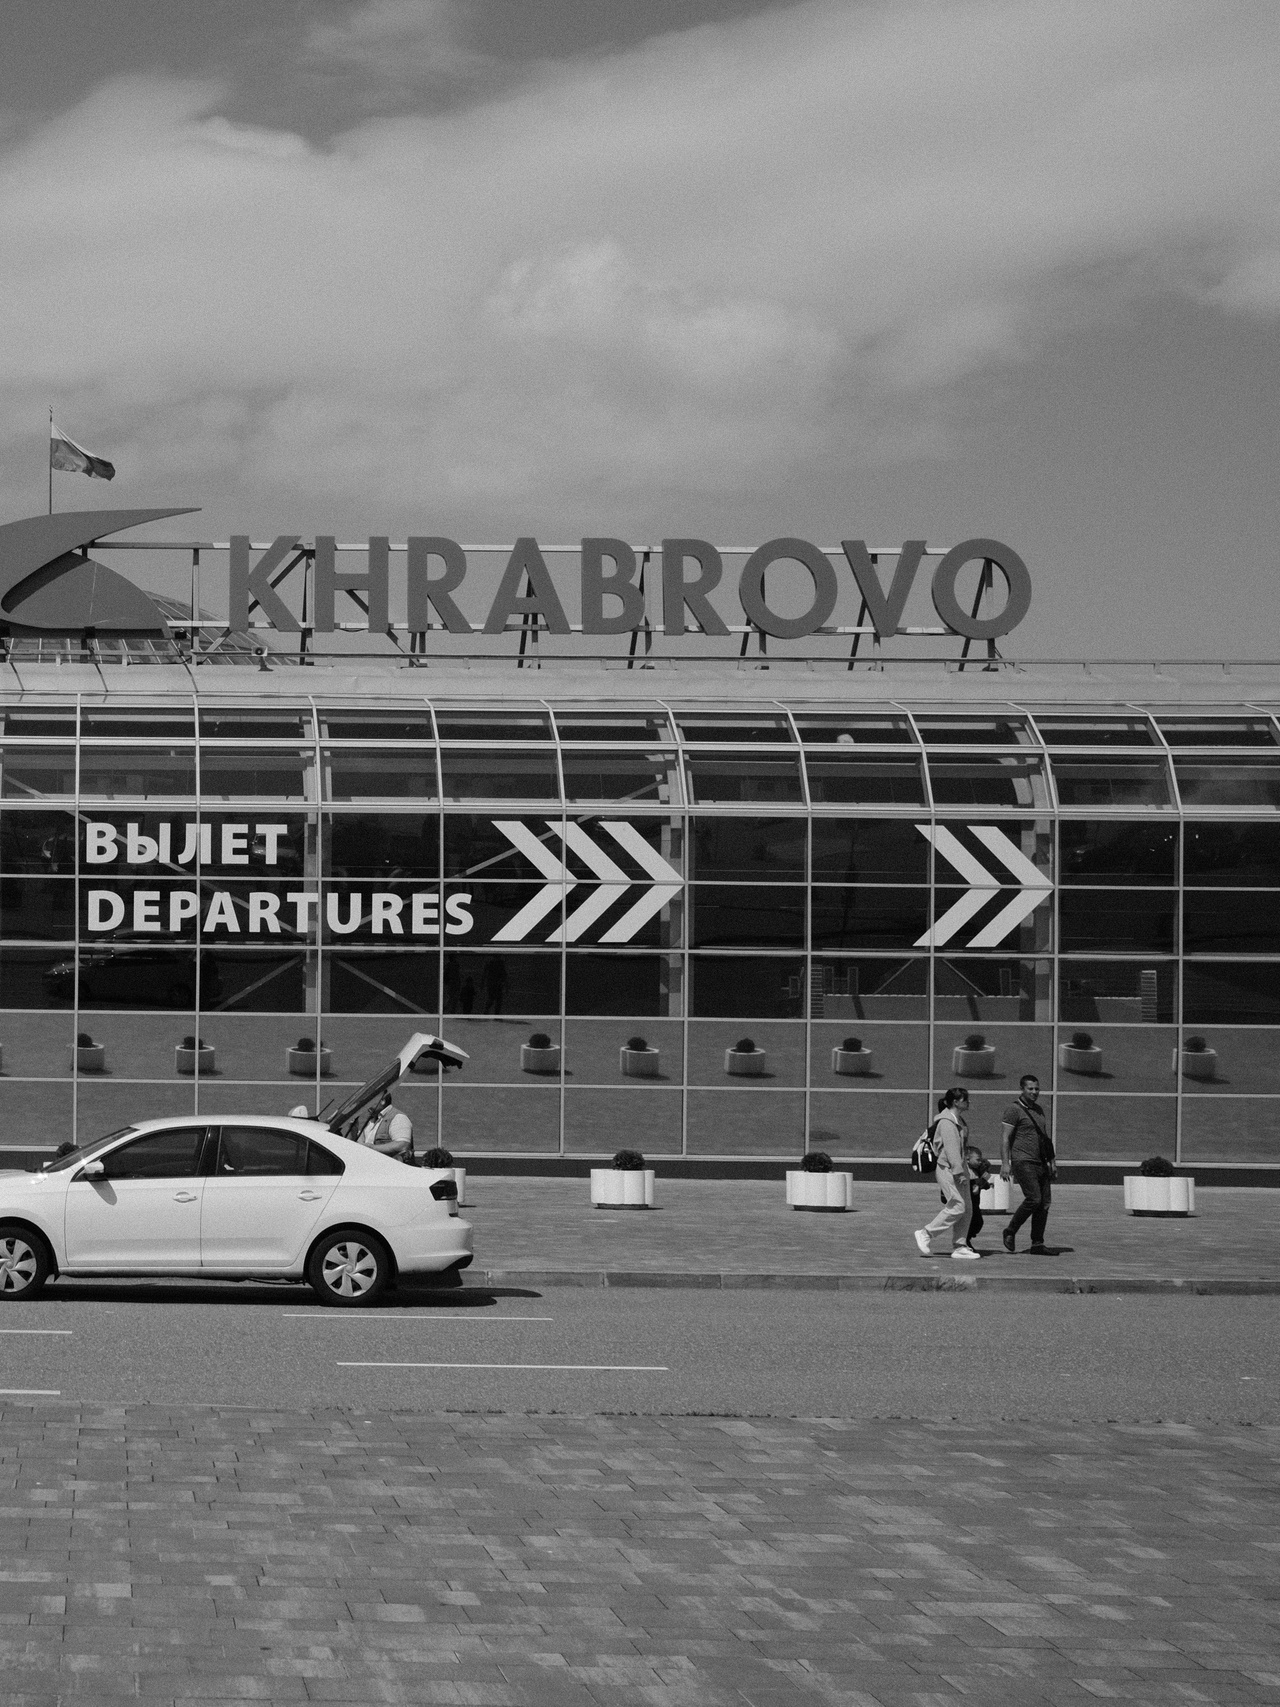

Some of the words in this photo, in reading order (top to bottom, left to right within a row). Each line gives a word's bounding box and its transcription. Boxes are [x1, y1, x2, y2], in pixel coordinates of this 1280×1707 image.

[229, 535, 1032, 640] KHRABROVO
[85, 822, 288, 865] ВЫЛЕТ
[87, 889, 475, 935] DEPARTURES
